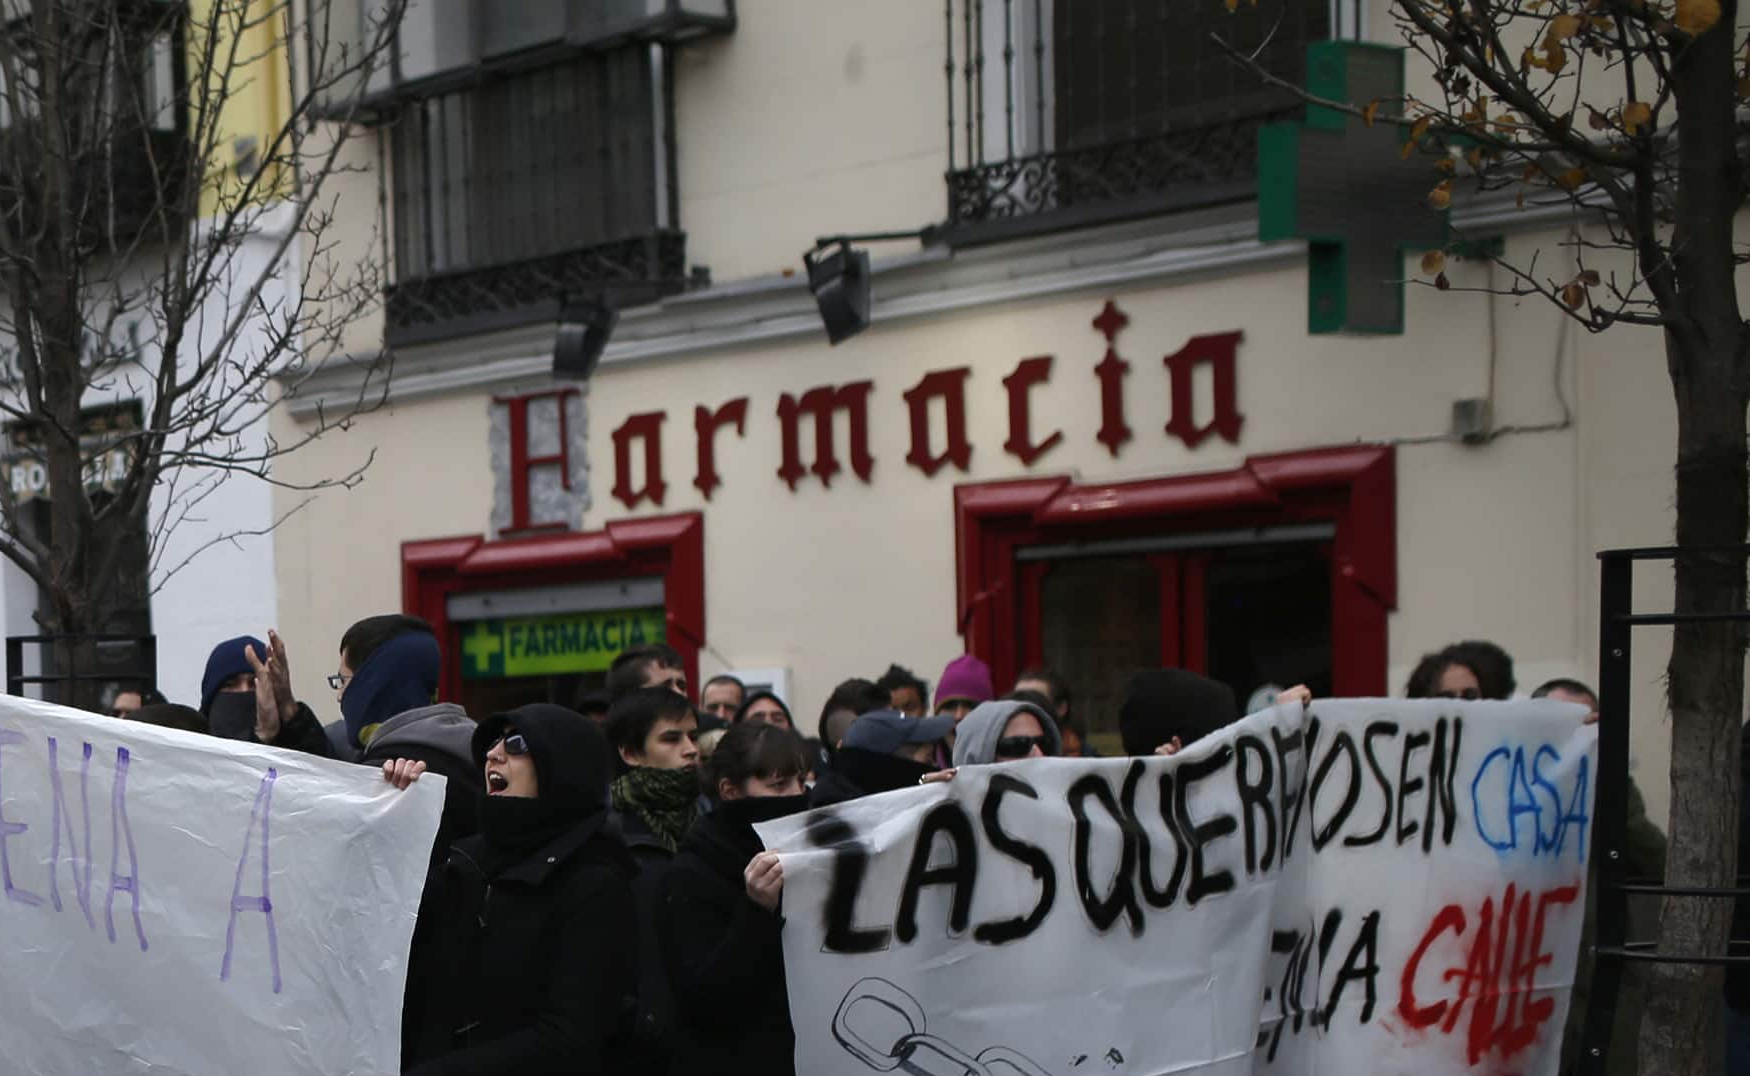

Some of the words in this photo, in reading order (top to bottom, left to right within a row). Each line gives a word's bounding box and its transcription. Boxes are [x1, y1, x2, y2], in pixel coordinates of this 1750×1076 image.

[510, 612, 647, 658] FARMACIA
[1472, 743, 1589, 863] CASA
[220, 766, 282, 995] A
